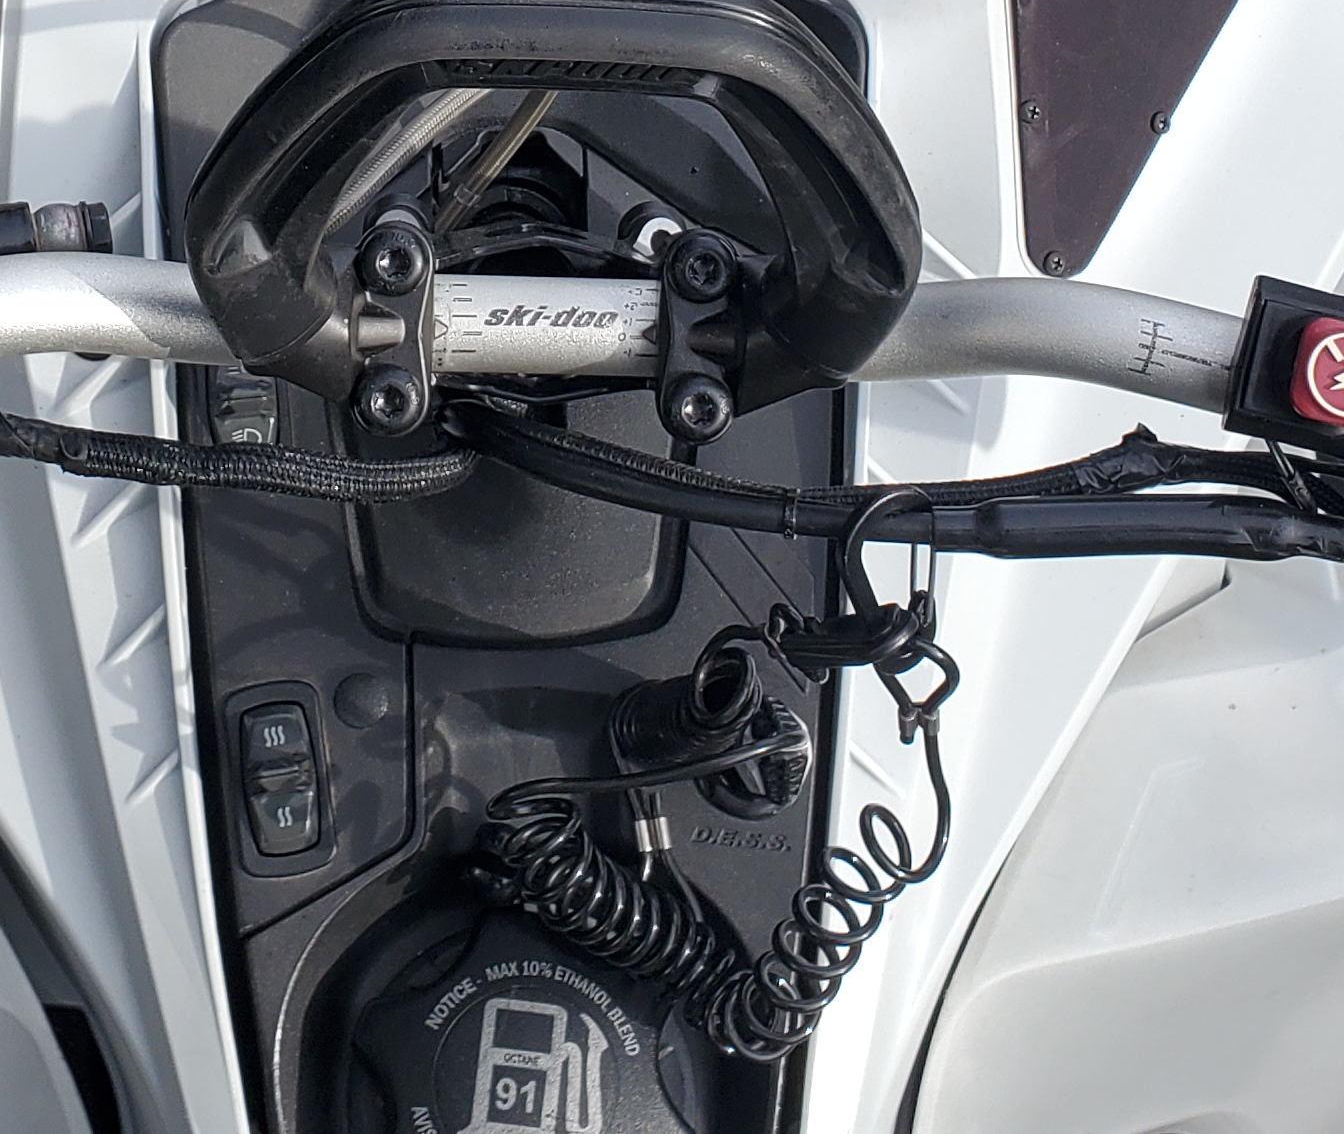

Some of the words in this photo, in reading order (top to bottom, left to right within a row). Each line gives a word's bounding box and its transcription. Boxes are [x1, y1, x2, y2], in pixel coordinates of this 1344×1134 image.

[484, 305, 618, 328] ski-doo
[424, 977, 478, 1030] NOTICE
[485, 960, 519, 982] MAX
[522, 960, 553, 978] 10%
[554, 965, 613, 1013] ETHANOL
[607, 1006, 641, 1056] BLEND
[504, 1052, 541, 1066] OCTANE
[494, 1077, 537, 1114] 91
